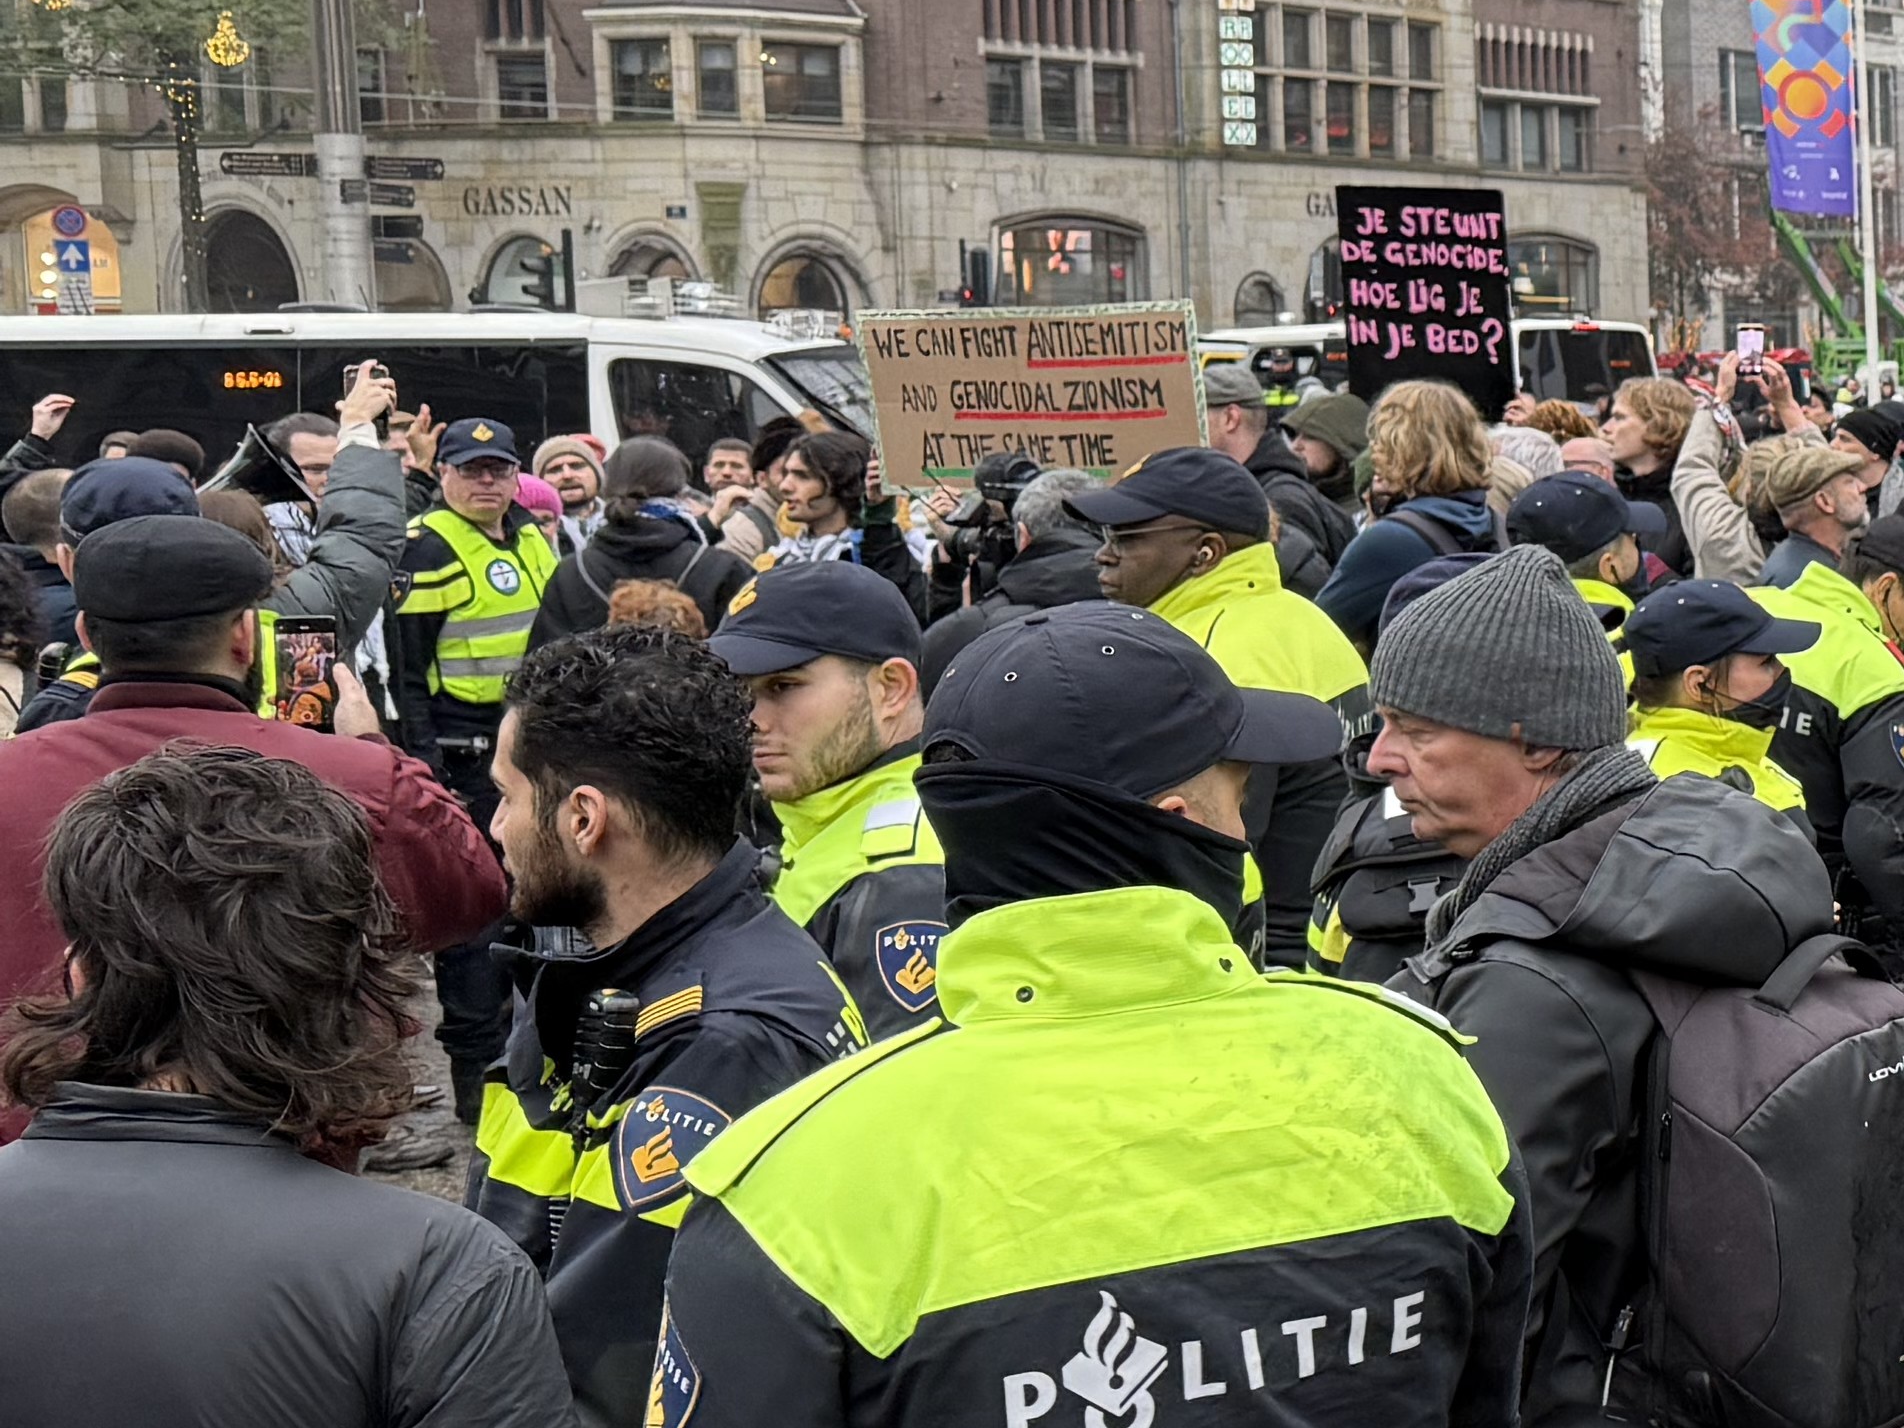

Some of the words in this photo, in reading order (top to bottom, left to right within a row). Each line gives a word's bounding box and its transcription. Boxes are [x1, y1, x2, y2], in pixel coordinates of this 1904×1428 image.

[463, 185, 573, 216] GASSAN
[1356, 207, 1388, 235] JE
[1399, 206, 1502, 240] STEUNT
[1340, 240, 1377, 263] DE
[1350, 278, 1401, 309] HOE
[1455, 281, 1484, 317] JE
[872, 328, 910, 359] WE
[915, 327, 956, 357] CAN
[961, 325, 1017, 359] FIGHT
[1027, 321, 1188, 359] ANTISEMITISM
[1383, 322, 1416, 360] JE
[1426, 317, 1504, 365] BED?
[901, 383, 937, 412] AND
[950, 379, 1061, 412] GENOCIDAL
[1063, 376, 1164, 410] ZIONISM
[921, 430, 946, 468] AT
[950, 433, 995, 466] THE
[1003, 431, 1055, 463] SAME
[1058, 434, 1118, 466] TIME
[884, 927, 937, 950] POLIT
[636, 1095, 717, 1137] POLITIE
